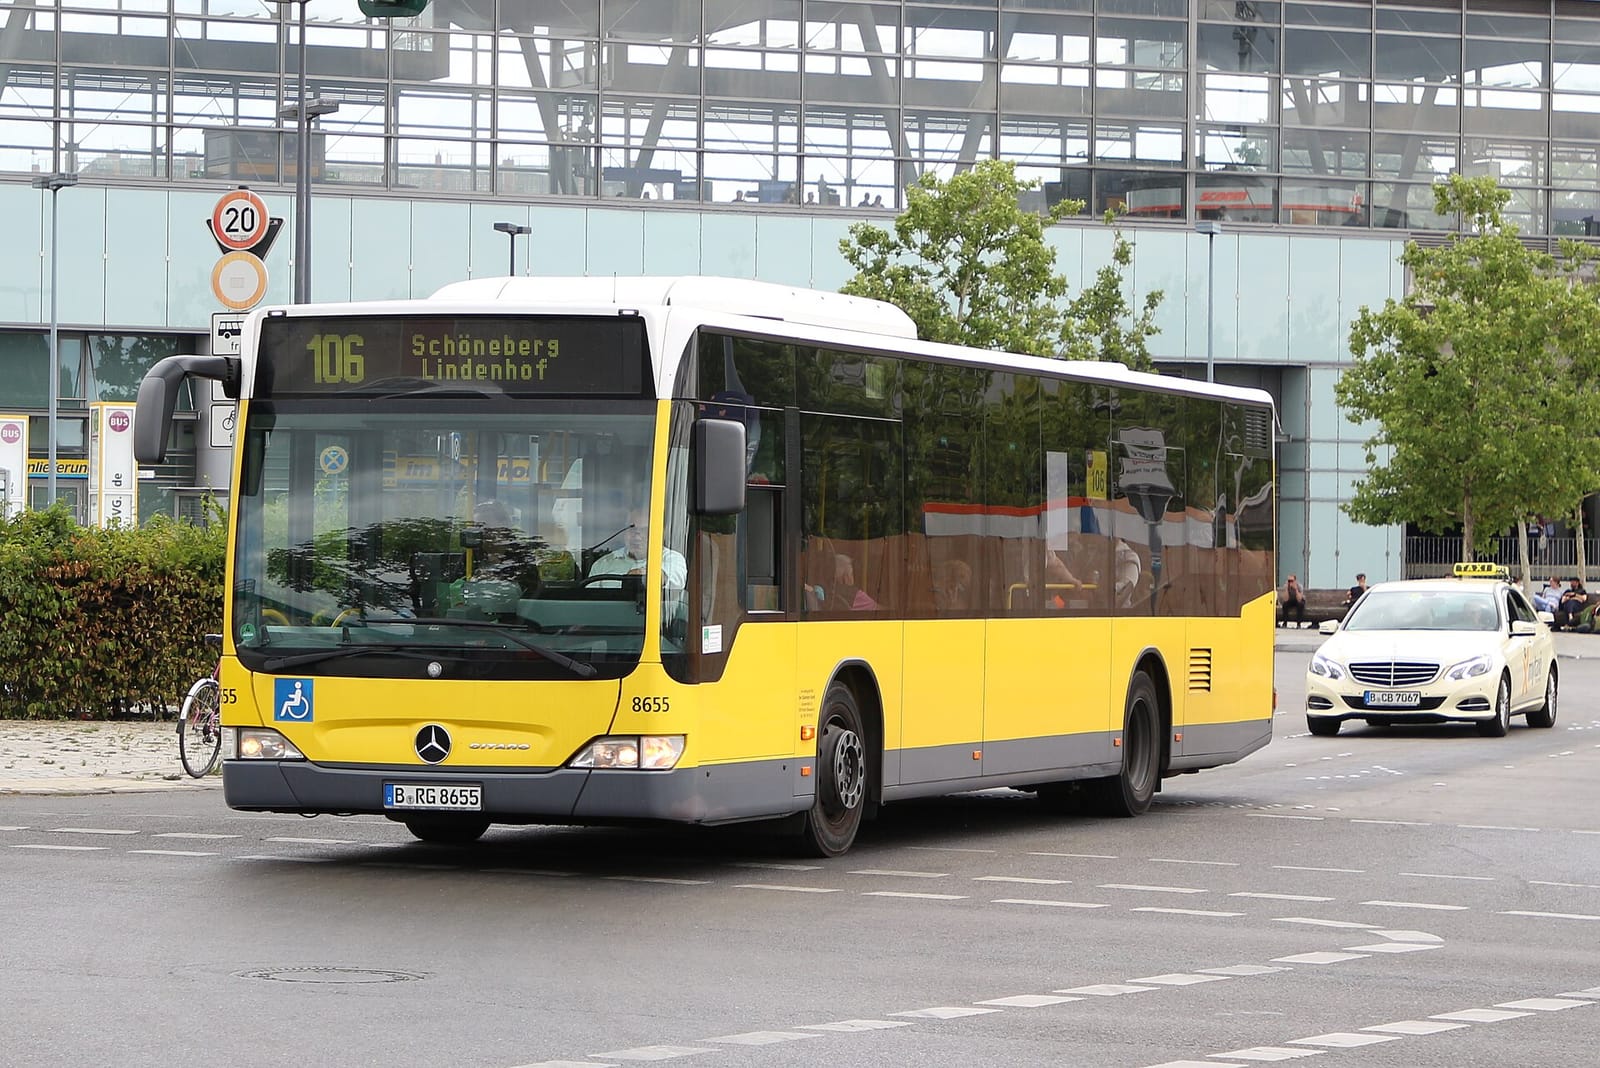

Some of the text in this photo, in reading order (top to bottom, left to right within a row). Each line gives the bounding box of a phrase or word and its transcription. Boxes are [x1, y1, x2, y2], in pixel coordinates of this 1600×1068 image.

[226, 207, 254, 232] 20
[412, 334, 559, 358] Schöneberg
[306, 334, 364, 384] 106
[422, 358, 548, 381] Lindenhof
[110, 417, 128, 427] BUS
[2, 429, 20, 438] BUS
[1456, 564, 1492, 572] TAXI
[220, 688, 237, 704] 55
[632, 696, 669, 712] 8655
[1395, 693, 1418, 702] 7067
[394, 787, 479, 806] B RG 8655
